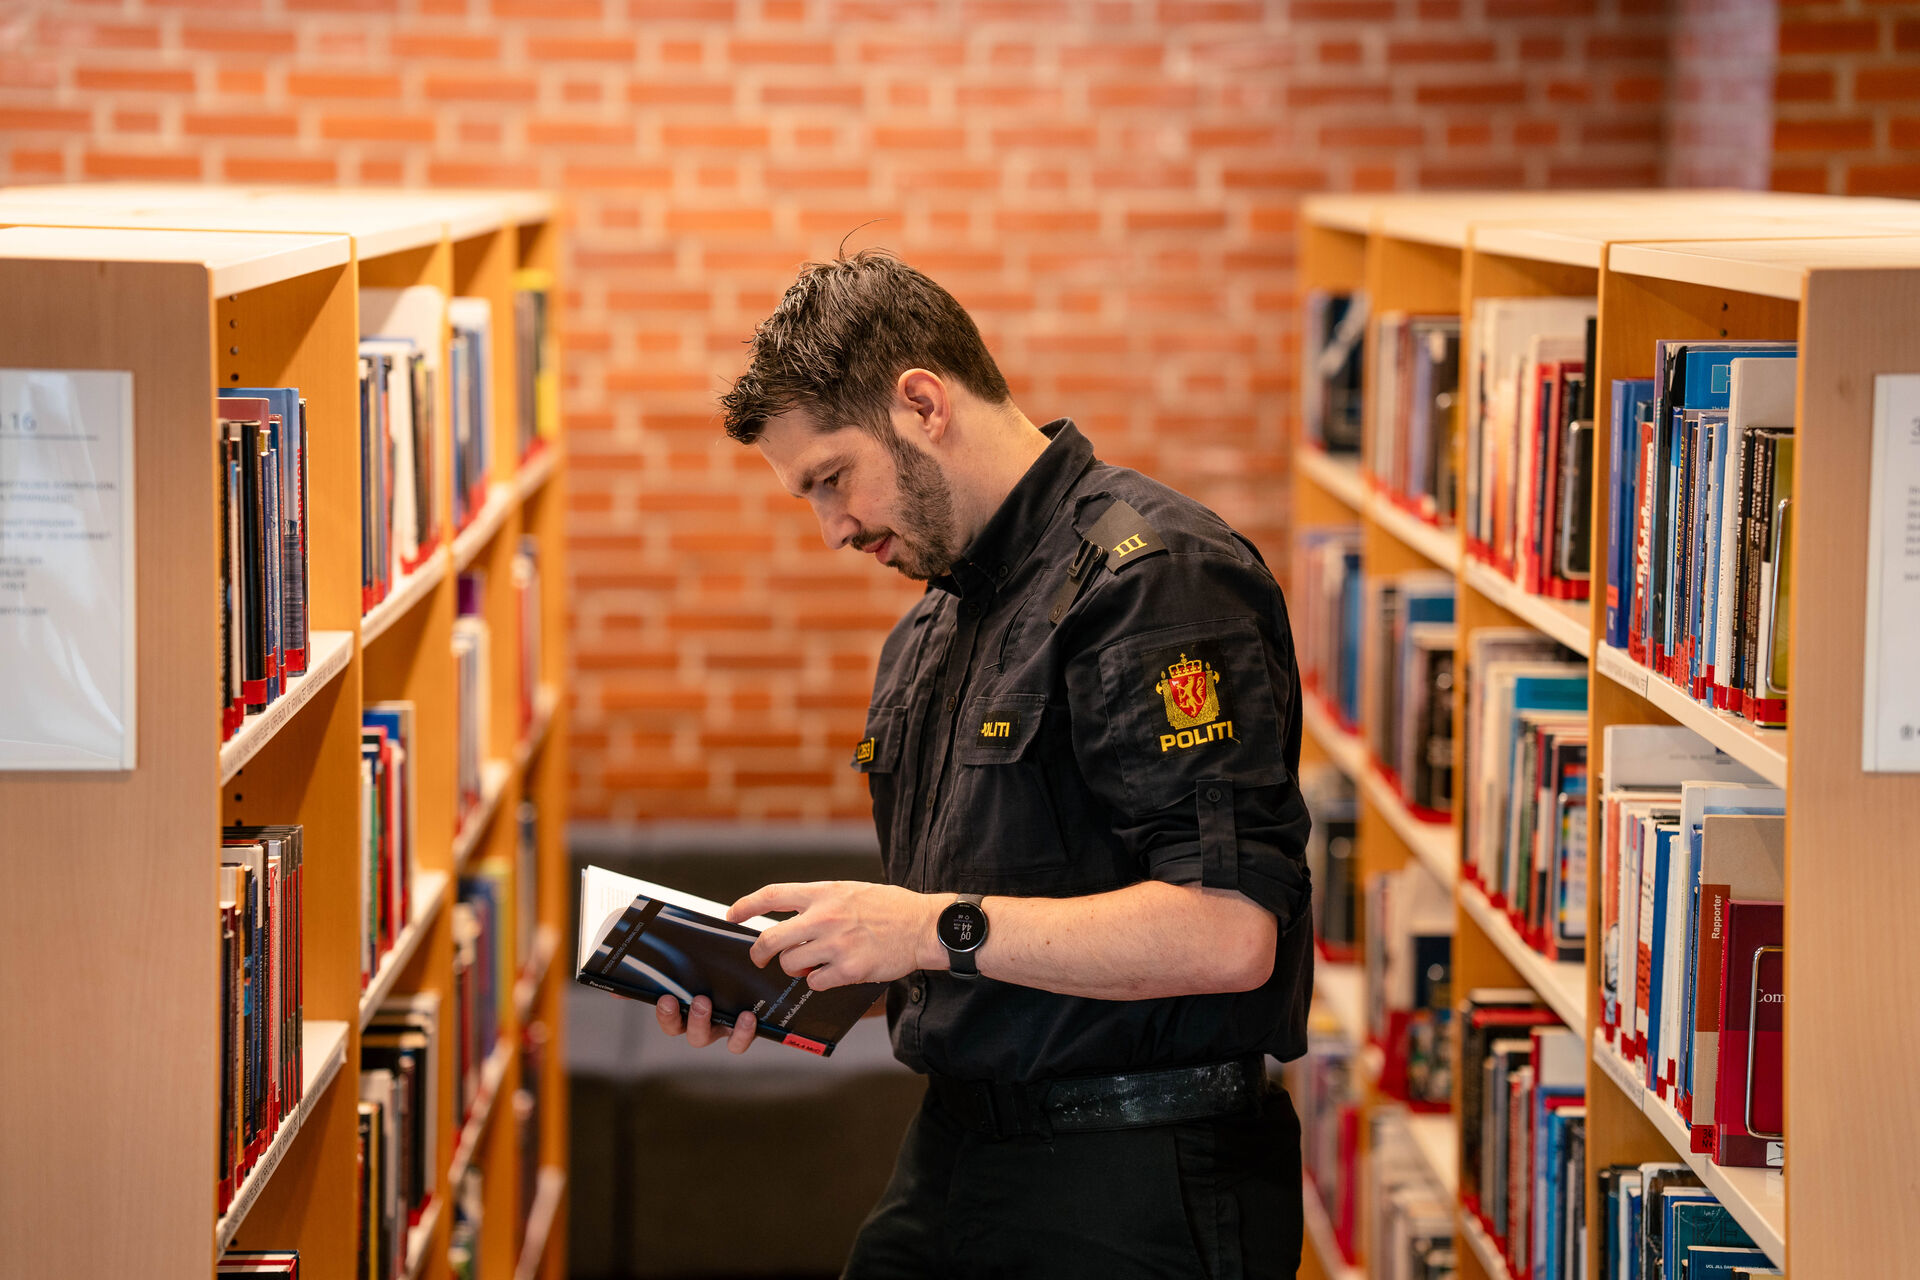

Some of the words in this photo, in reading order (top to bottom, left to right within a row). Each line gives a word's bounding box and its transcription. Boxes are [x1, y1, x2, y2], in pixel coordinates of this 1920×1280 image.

[1112, 533, 1148, 558] III
[1159, 720, 1234, 752] POLITI
[1712, 894, 1722, 940] Rapporter
